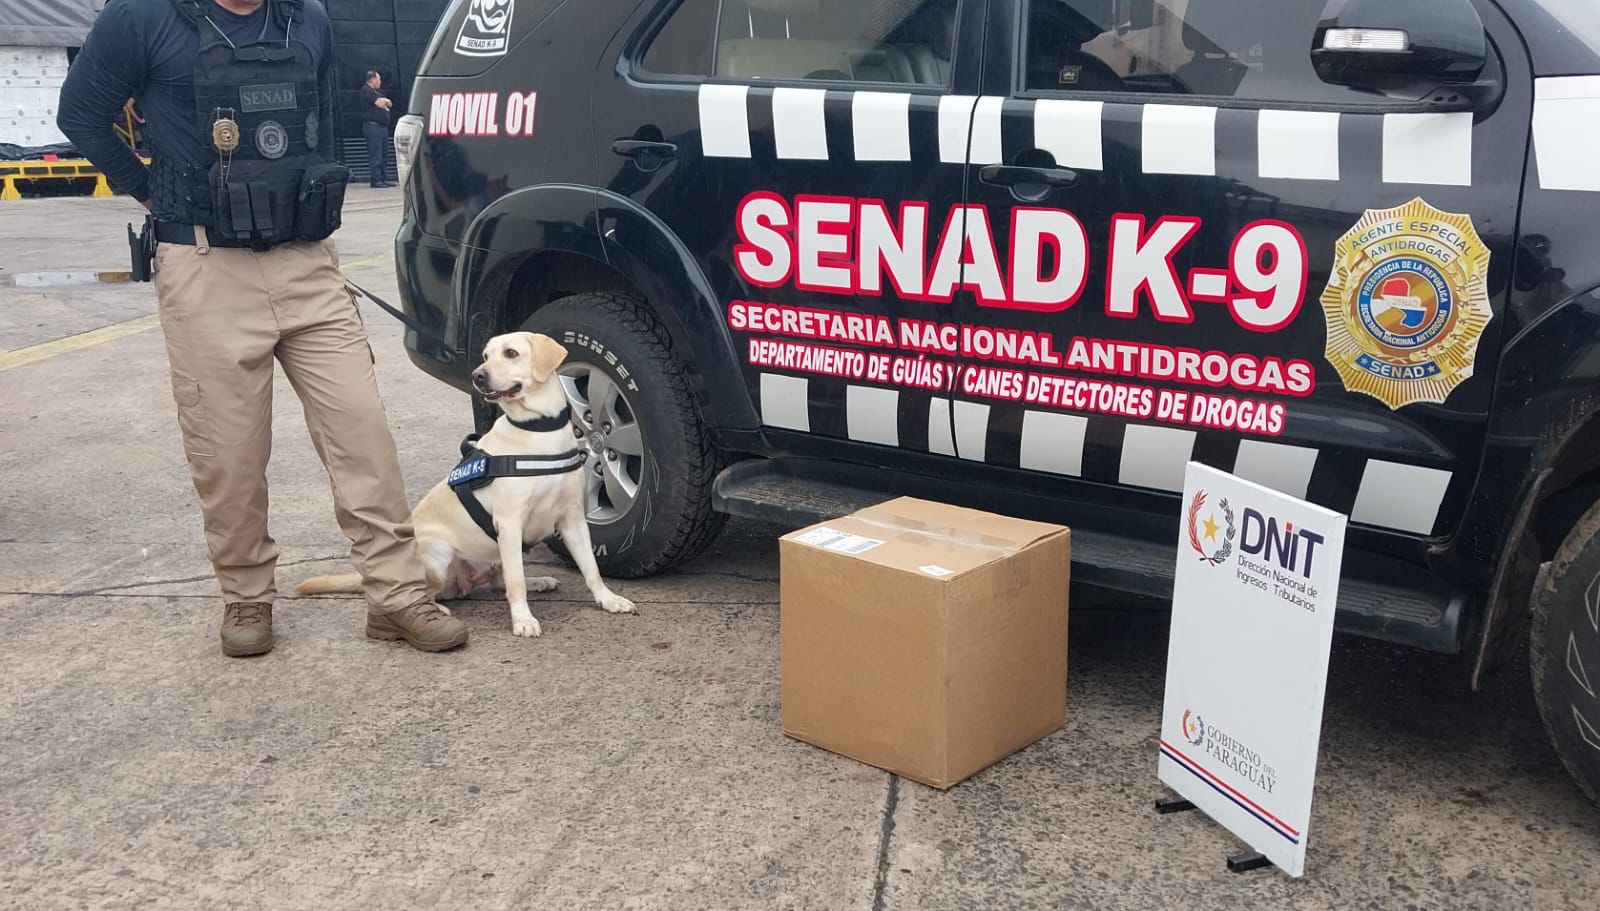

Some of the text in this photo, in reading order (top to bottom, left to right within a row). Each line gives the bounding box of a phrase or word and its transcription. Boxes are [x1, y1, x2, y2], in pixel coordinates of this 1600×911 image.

[467, 39, 486, 48] SENAD
[242, 89, 293, 106] SENAD
[429, 91, 537, 136] MOVIL 01
[1351, 221, 1472, 256] AGENTE ESPECIAL
[1371, 241, 1452, 264] ANTIDROGAS
[734, 191, 1308, 332] SENAD K-9
[1362, 261, 1400, 296] PRESIDENCIA
[1401, 260, 1412, 269] DE
[1413, 261, 1422, 271] LA
[563, 330, 641, 393] SUNSET
[728, 300, 1313, 394] SECRETARIA NACIONAL ANTIDROGAS
[749, 340, 1286, 435] DEPARTAMENTO DE GUÍAS Y CANES DETECTORES DE DROGAS
[1369, 361, 1425, 379] SENAD
[449, 463, 472, 482] SENAD
[1236, 568, 1316, 613] Ingresos Tributarios
[1237, 555, 1318, 599] Dirección Nacional de
[1206, 724, 1278, 779] GOBIERNO DEL
[1206, 738, 1277, 794] PARAGUAY
